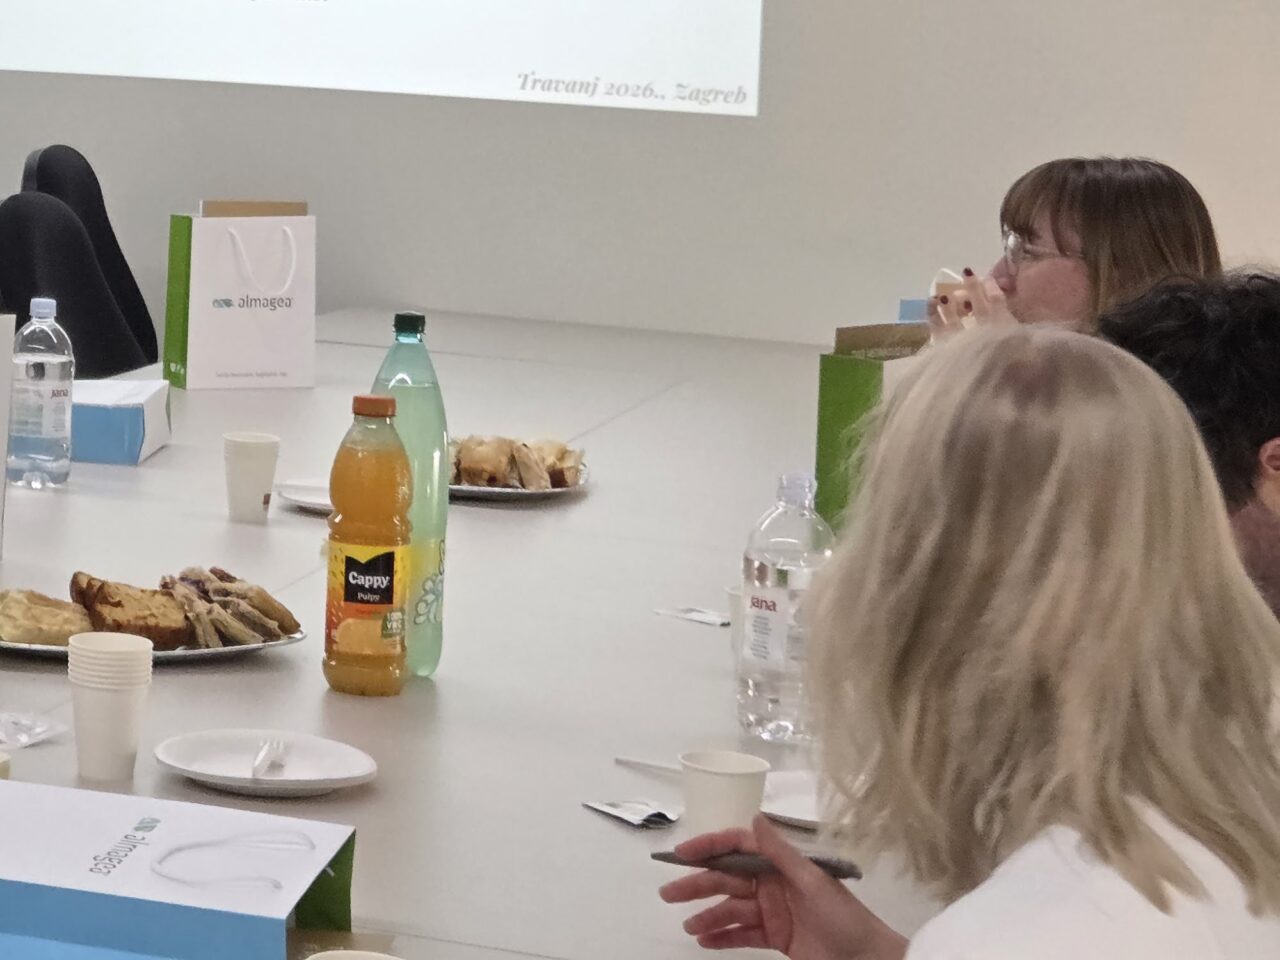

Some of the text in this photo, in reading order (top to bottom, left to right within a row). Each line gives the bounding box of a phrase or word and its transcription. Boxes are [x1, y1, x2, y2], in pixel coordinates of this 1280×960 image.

[517, 70, 601, 98] Travanj
[673, 82, 748, 106] Zagreb
[238, 294, 292, 311] almagea
[348, 571, 391, 589] Cappy
[357, 592, 380, 603] Pulpy
